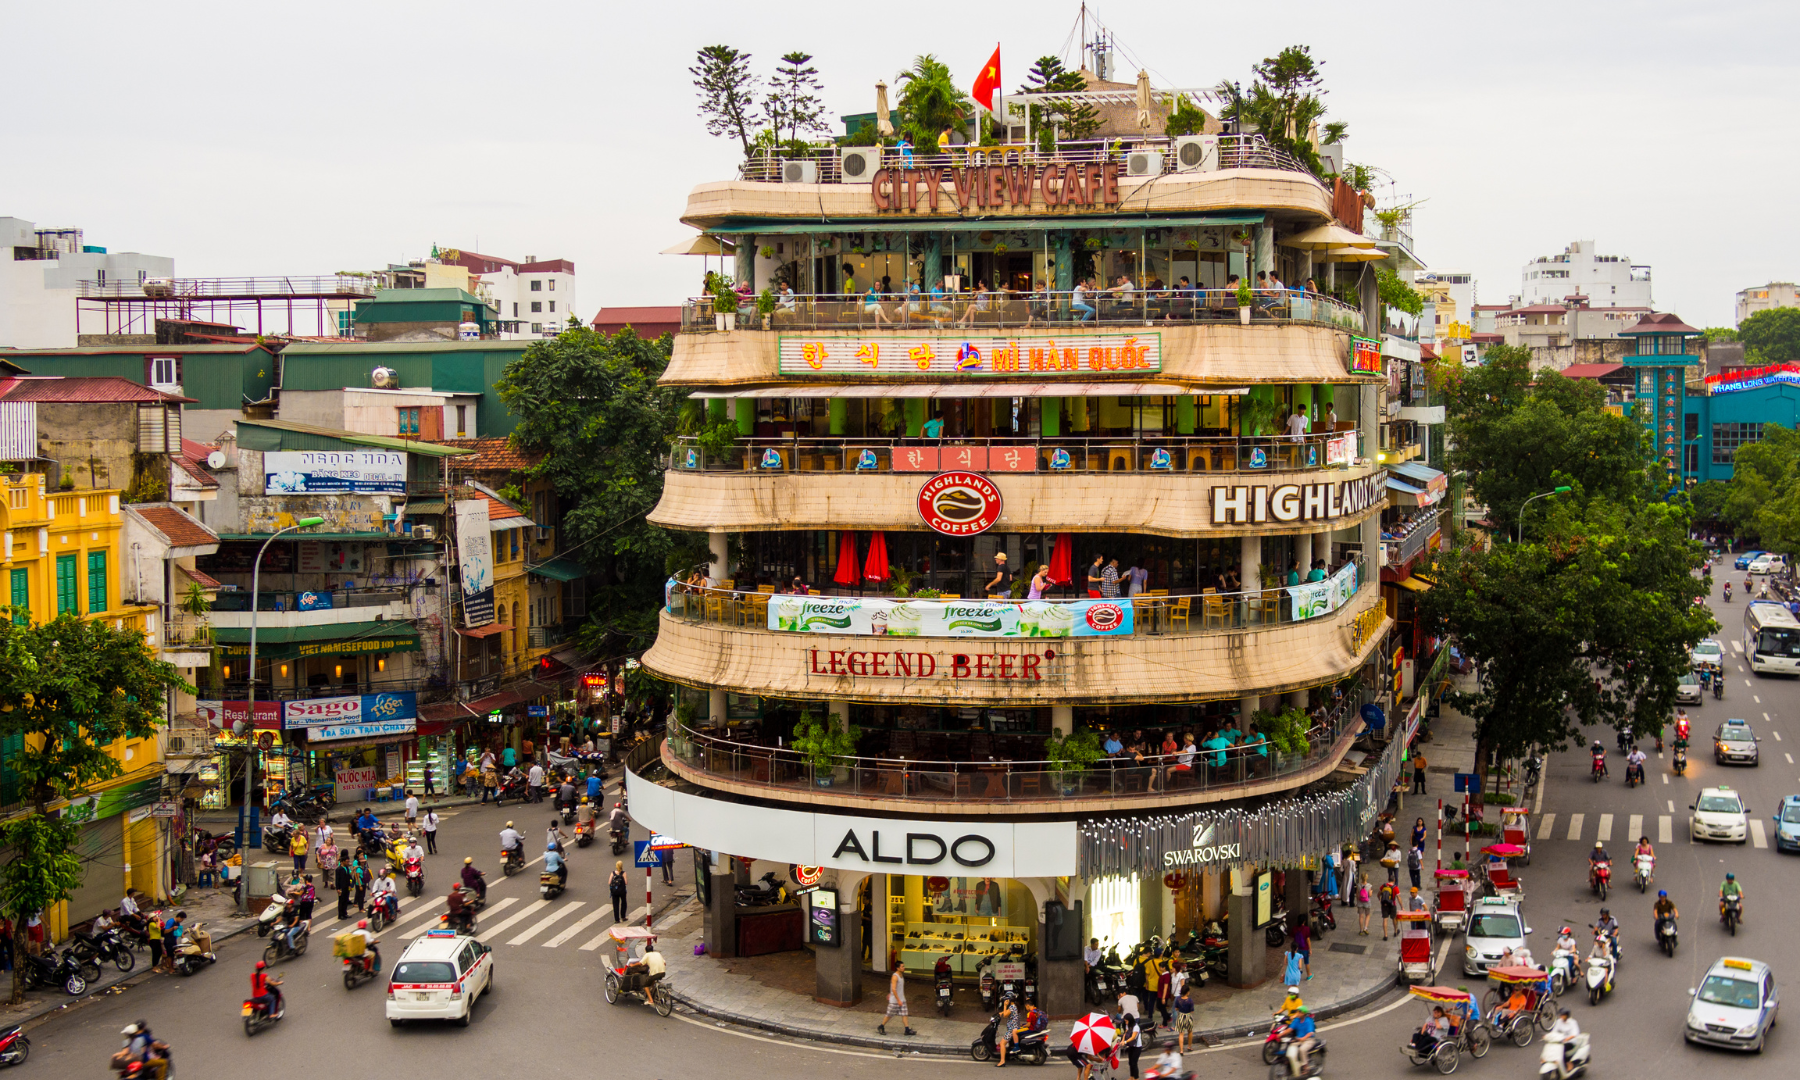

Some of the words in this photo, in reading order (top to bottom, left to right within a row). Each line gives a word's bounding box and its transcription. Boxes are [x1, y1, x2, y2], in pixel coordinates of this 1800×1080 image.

[872, 167, 944, 210] CITY
[951, 164, 1036, 208] VIEW
[1041, 162, 1119, 206] CAFE
[991, 342, 1019, 371] MÌ
[1029, 340, 1079, 371] HÀN
[1088, 336, 1151, 371] QUỐC
[340, 470, 360, 478] KEO
[922, 475, 997, 502] HIGHLANDS
[1211, 476, 1368, 524] HIGHLANDS
[931, 517, 988, 533] COFFEE
[801, 601, 844, 616] freeze
[942, 604, 994, 620] freeze
[1087, 603, 1122, 617] HIGHLANDS
[1091, 621, 1119, 630] COFFEE
[811, 649, 936, 678] LEGEND
[951, 653, 1042, 681] BEER
[225, 709, 278, 721] Resturant
[288, 701, 358, 717] Sago
[371, 697, 404, 717] Tiger
[832, 828, 996, 867] ALDO
[1164, 842, 1241, 867] SWAROVSKI
